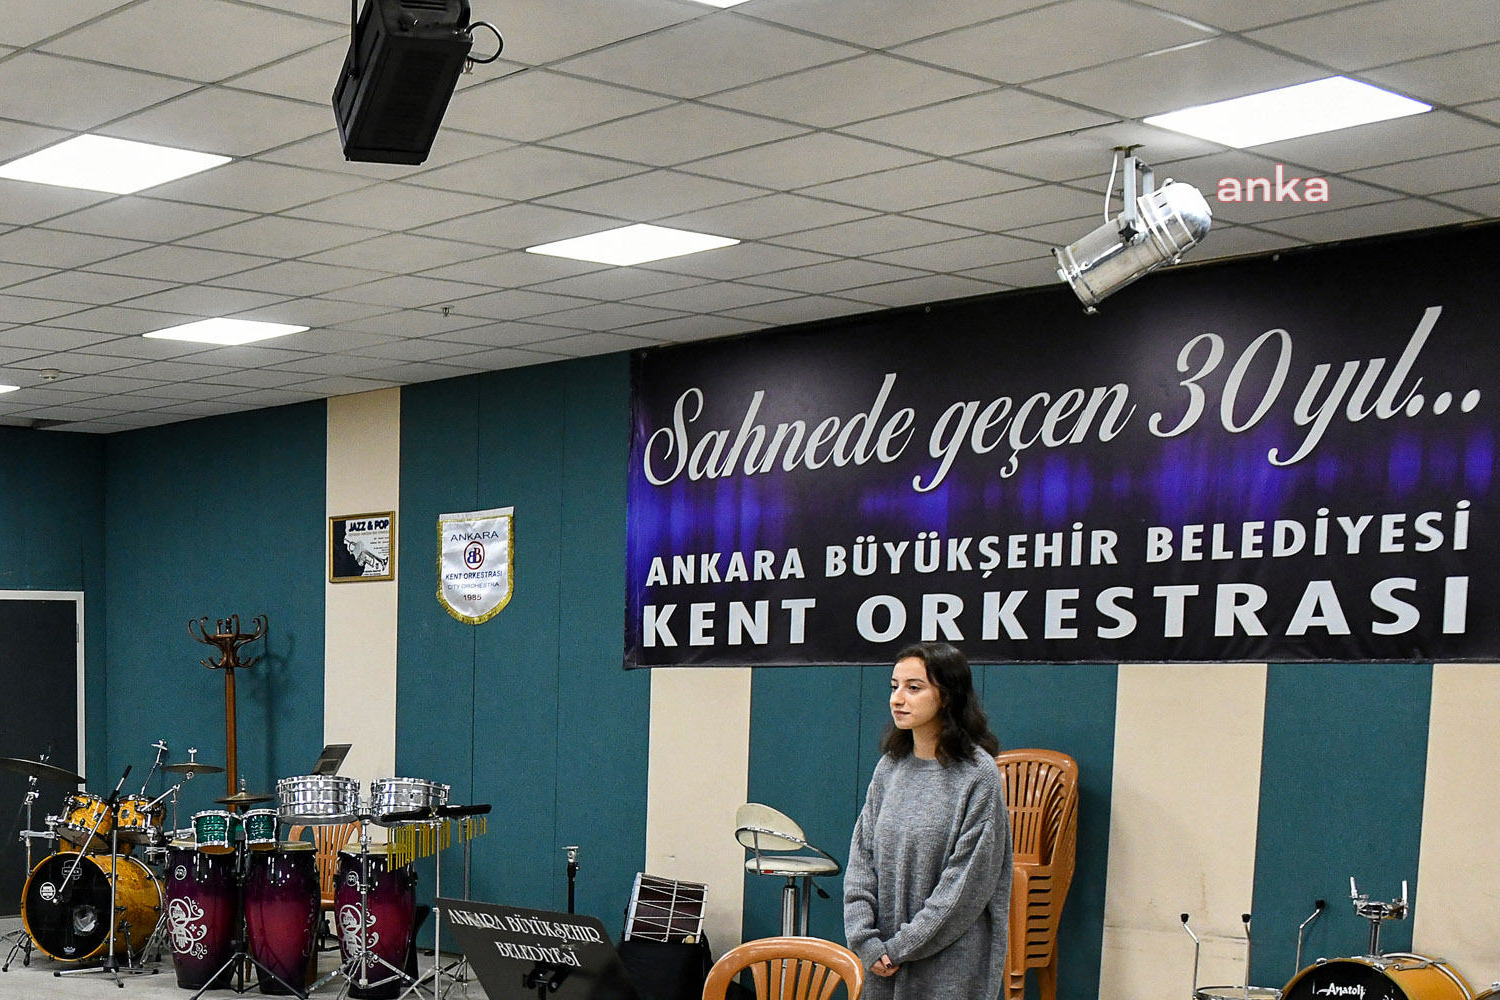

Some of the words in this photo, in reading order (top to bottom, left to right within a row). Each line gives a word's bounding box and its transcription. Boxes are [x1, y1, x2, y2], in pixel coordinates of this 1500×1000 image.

[643, 373, 915, 486] Sahnede
[912, 382, 1137, 493] geçen
[1148, 328, 1293, 438] 30
[349, 521, 366, 532] JAZZ
[367, 520, 373, 530] &
[374, 519, 389, 530] POP
[450, 530, 499, 542] ANKARA
[646, 548, 805, 586] ANKARA
[825, 522, 1118, 579] BÜYÜKŞEHİR
[1146, 500, 1471, 563] BELEDİYESİ
[445, 572, 462, 580] KENT
[463, 570, 503, 580] ORKESTRASI
[462, 582, 500, 590] ORCHESTRA
[643, 598, 816, 647] KENT
[856, 576, 1469, 642] ORKESTRASI
[448, 908, 507, 931] ANKARA
[494, 941, 582, 967] BELEDİYESİ
